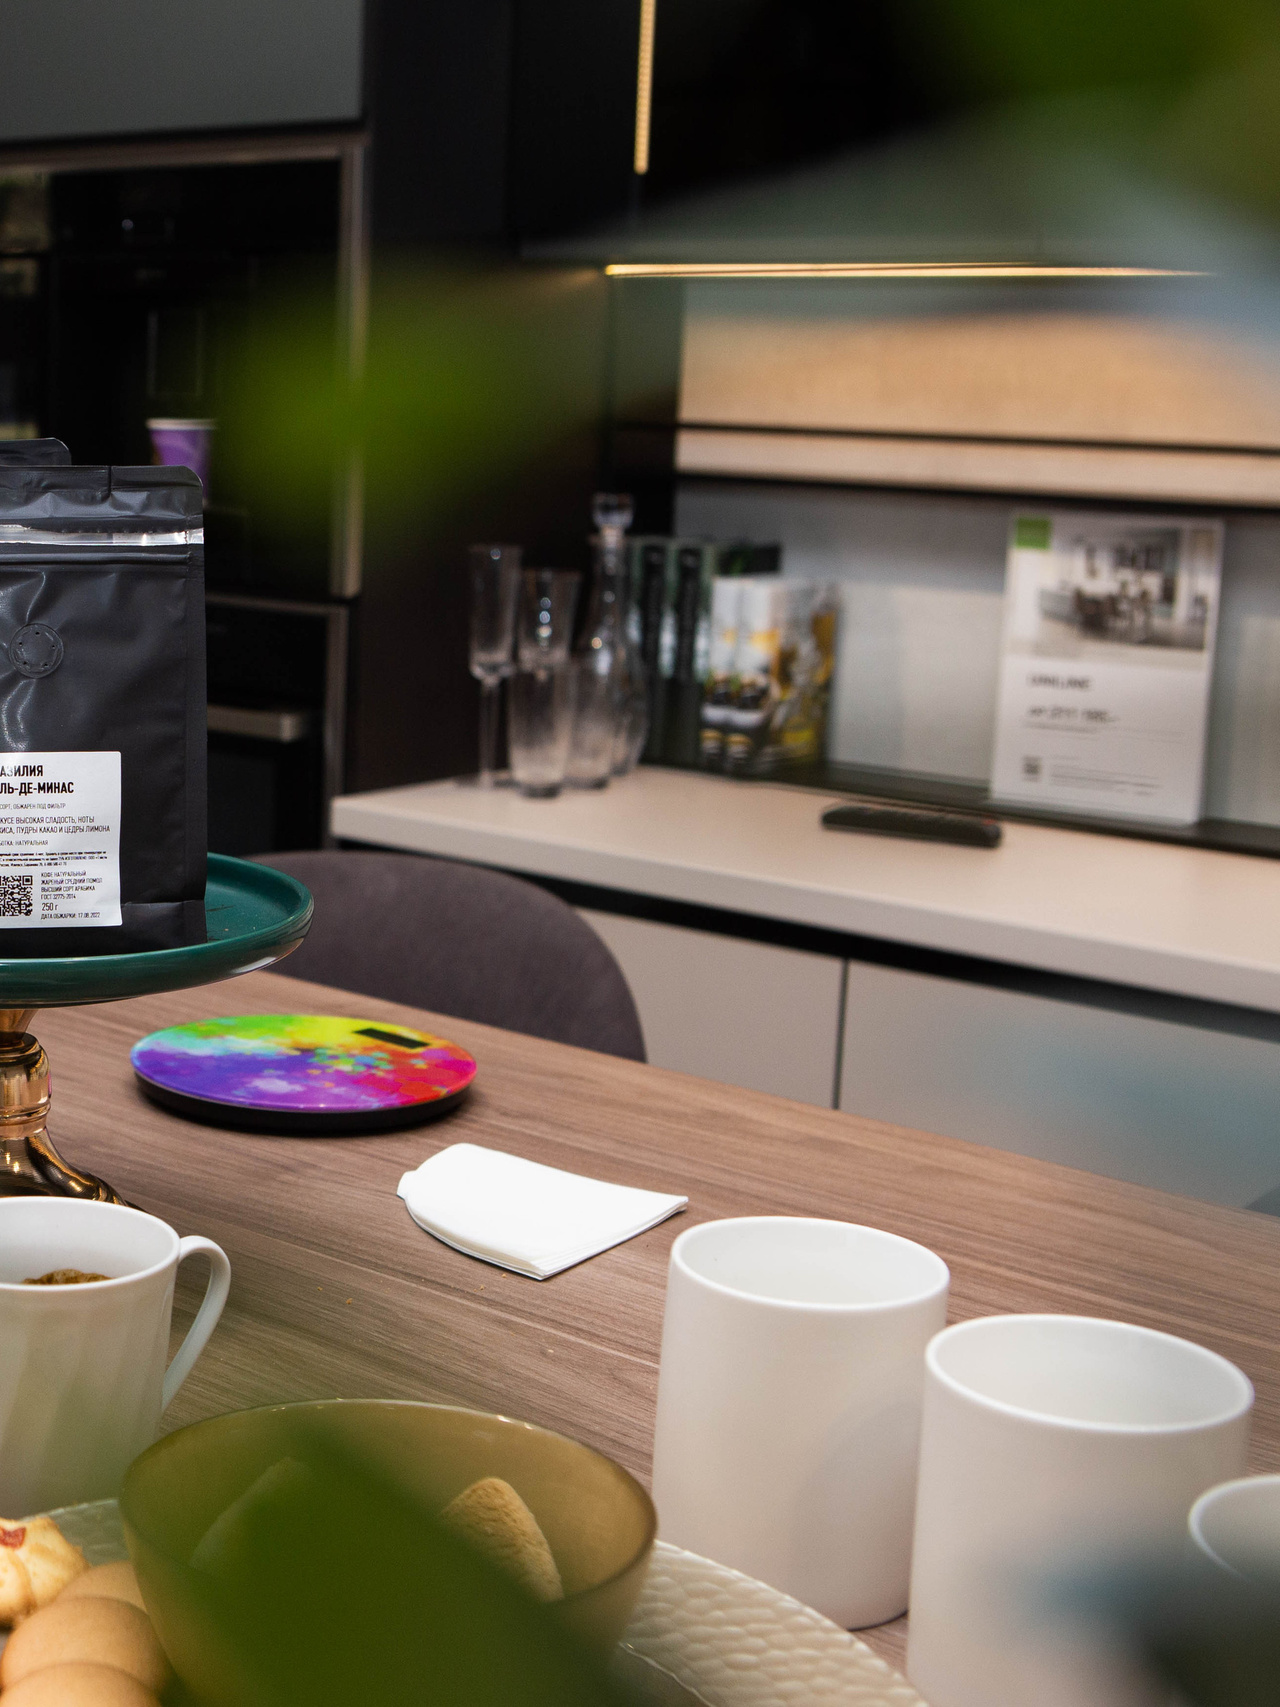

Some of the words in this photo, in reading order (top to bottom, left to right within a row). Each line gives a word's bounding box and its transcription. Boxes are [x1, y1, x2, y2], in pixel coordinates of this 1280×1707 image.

[45, 816, 76, 824] СЛАДОСТЬ,
[16, 826, 38, 834] ПУДРЫ
[64, 826, 85, 834] ЦЕДРЫ
[85, 825, 110, 833] ЛИМОНА
[42, 903, 53, 911] 250
